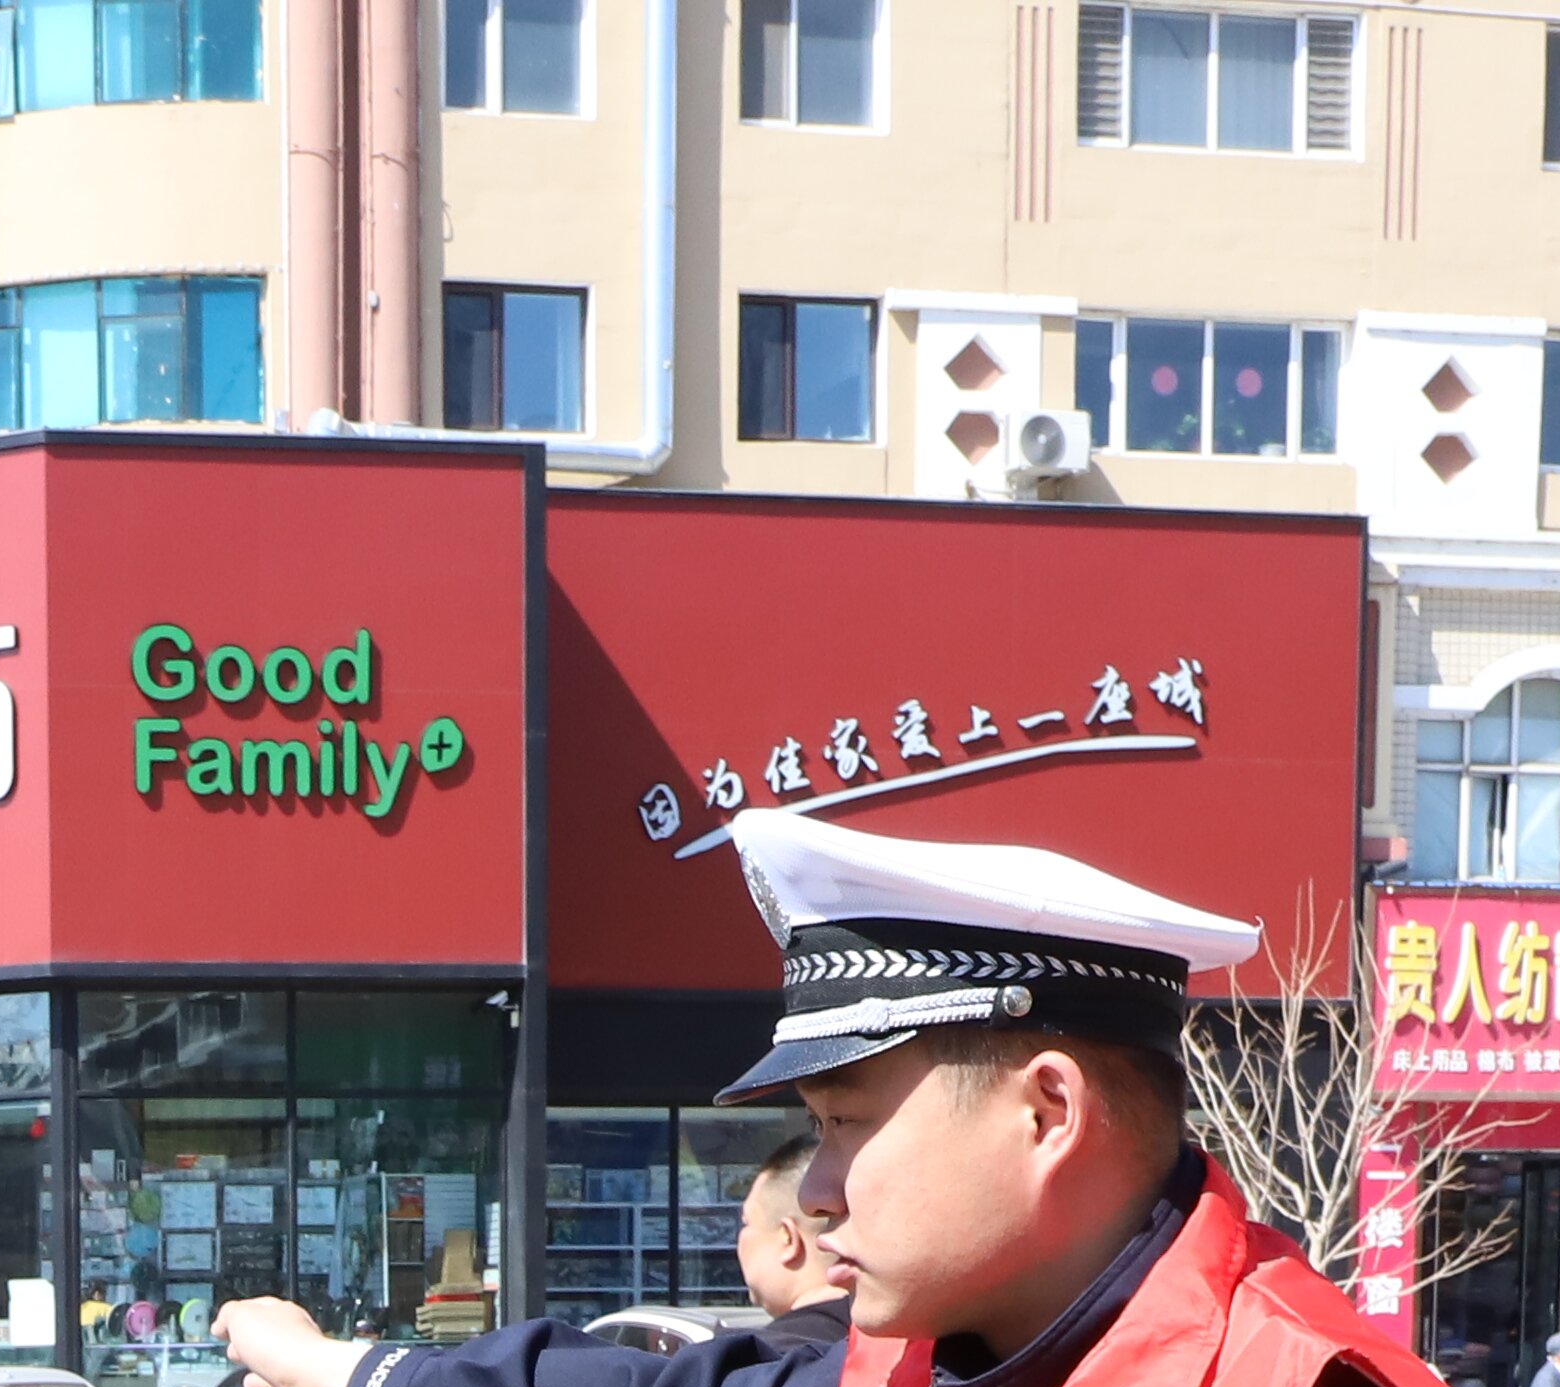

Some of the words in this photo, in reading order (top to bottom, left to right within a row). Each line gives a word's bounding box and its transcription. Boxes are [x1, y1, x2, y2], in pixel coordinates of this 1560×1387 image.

[131, 623, 374, 706] Good
[132, 717, 410, 819] Family
[638, 657, 1207, 842] 因为佳家爱上一座城
[1392, 1049, 1469, 1073] 床上用品
[1363, 1143, 1407, 1316] 二楼窗
